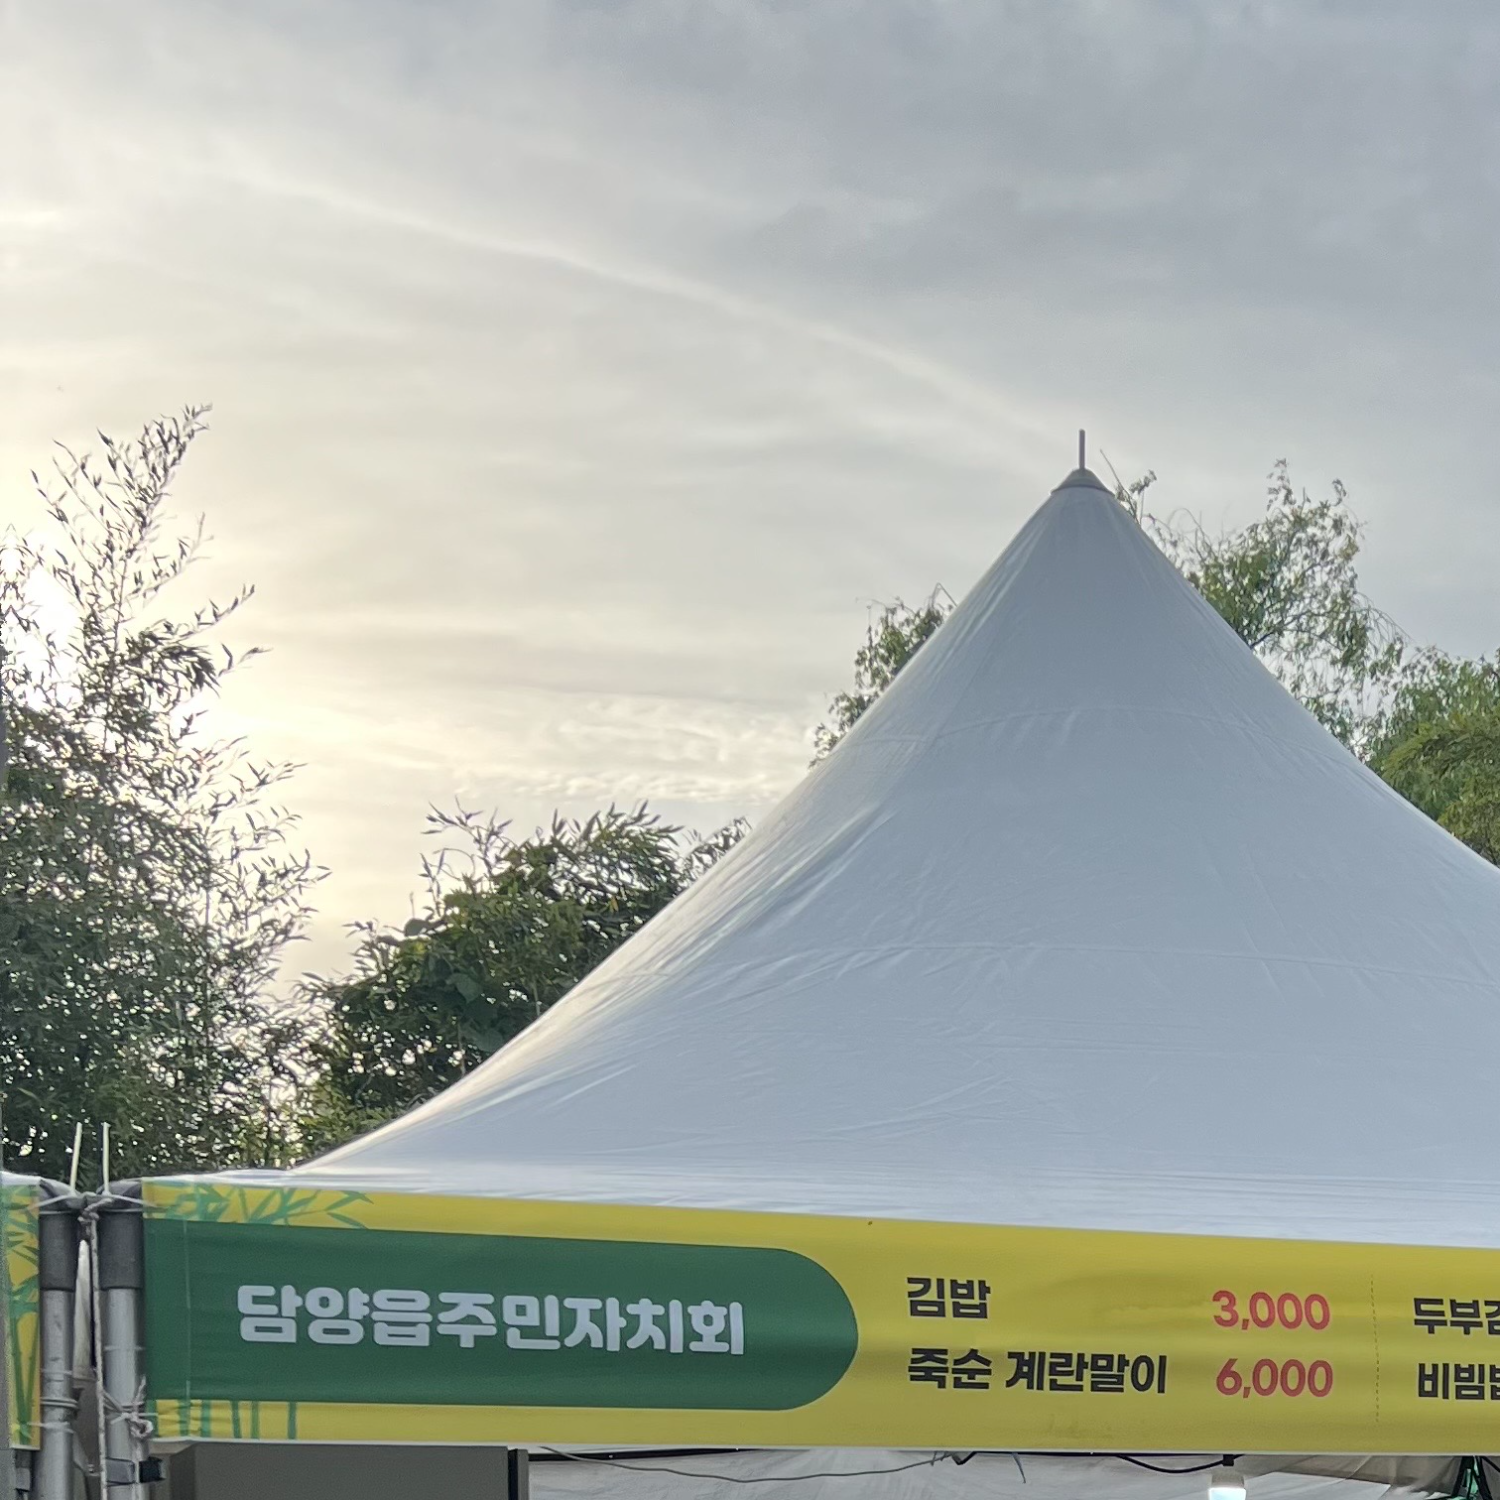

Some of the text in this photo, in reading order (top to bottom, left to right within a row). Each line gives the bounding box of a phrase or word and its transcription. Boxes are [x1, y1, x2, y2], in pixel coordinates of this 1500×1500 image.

[236, 1284, 744, 1355] 담양읍주민자치회
[906, 1277, 1331, 1330] 김밥 3,000
[907, 1347, 1333, 1399] 죽순 계란말이 6,000
